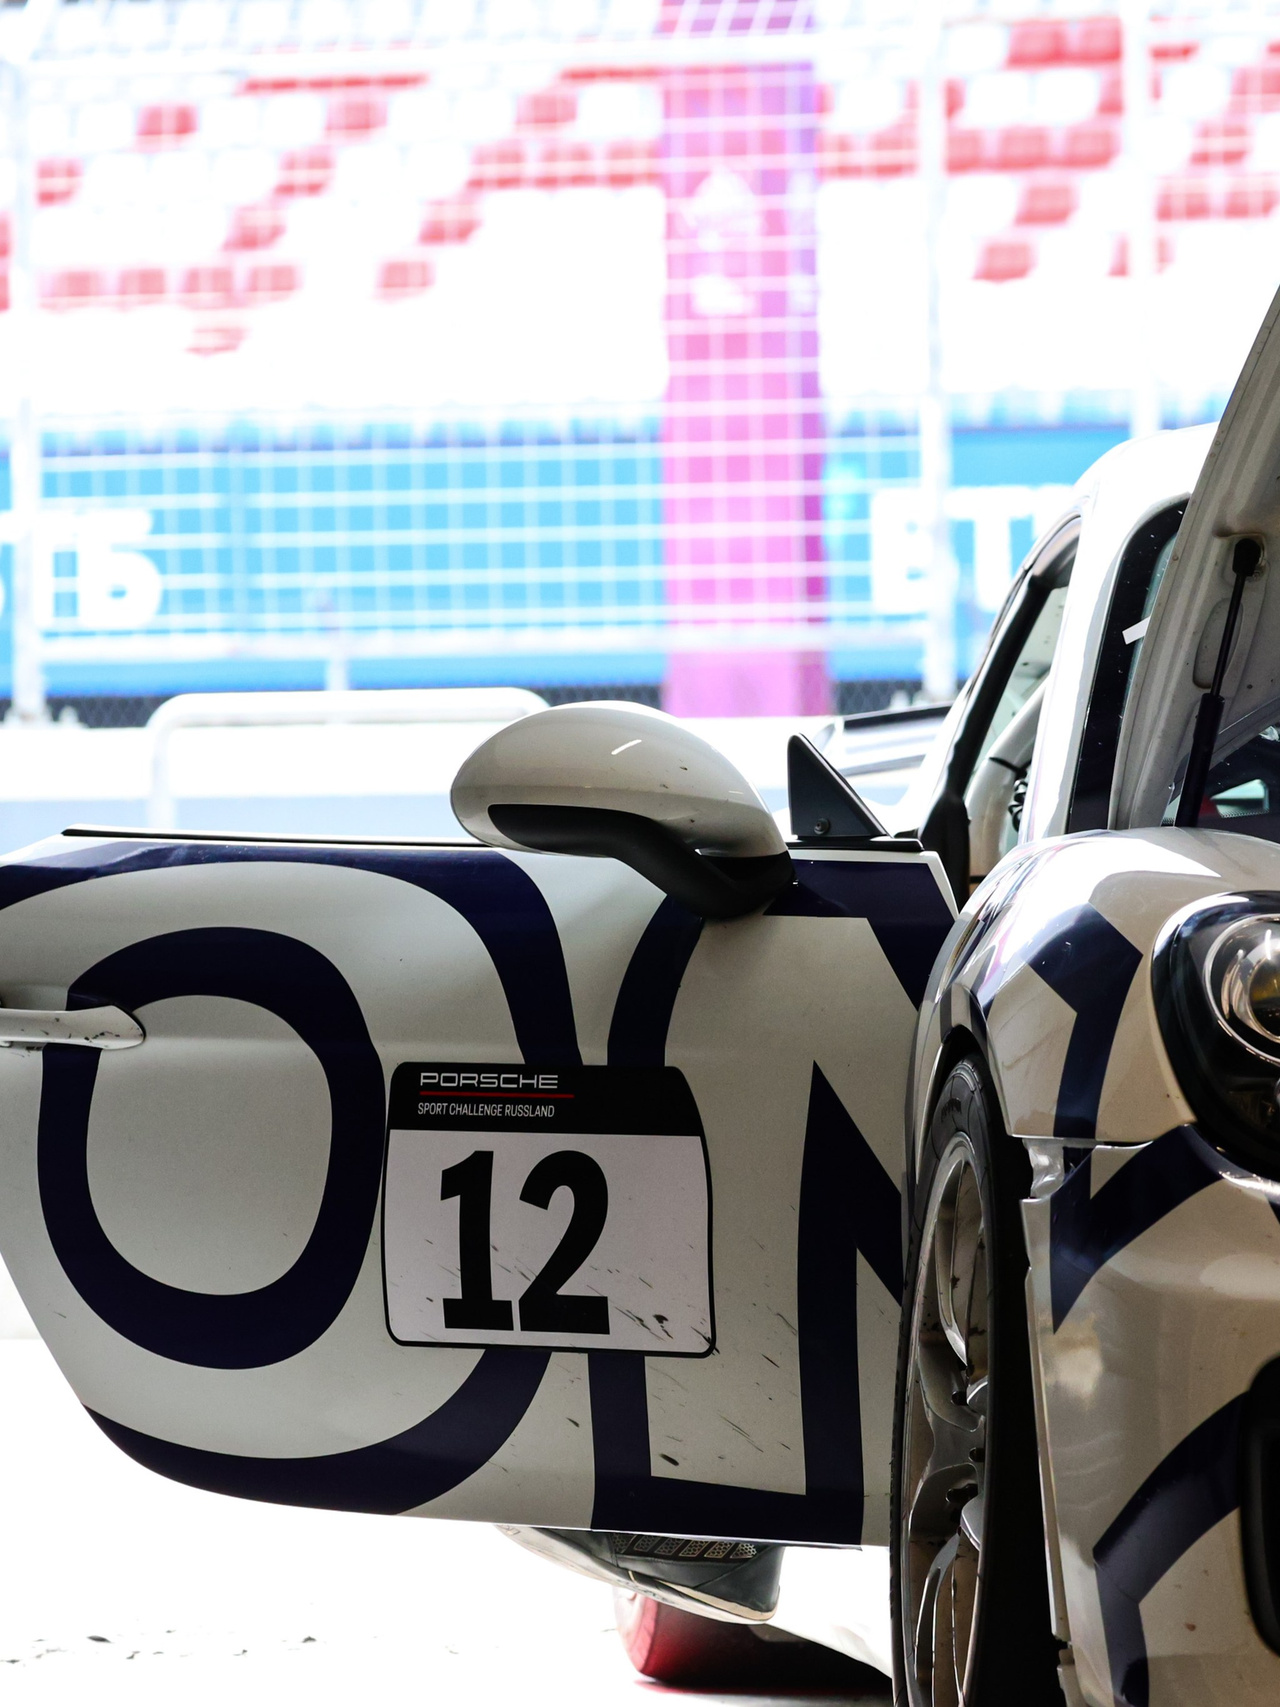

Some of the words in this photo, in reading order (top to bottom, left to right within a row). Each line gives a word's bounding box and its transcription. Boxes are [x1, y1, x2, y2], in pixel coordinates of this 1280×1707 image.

[419, 1072, 559, 1089] PORSCHE
[417, 1103, 448, 1116] SPORT
[449, 1103, 503, 1117] CHALLENGE
[504, 1105, 555, 1118] RUSSLAND
[440, 1150, 610, 1335] 12
